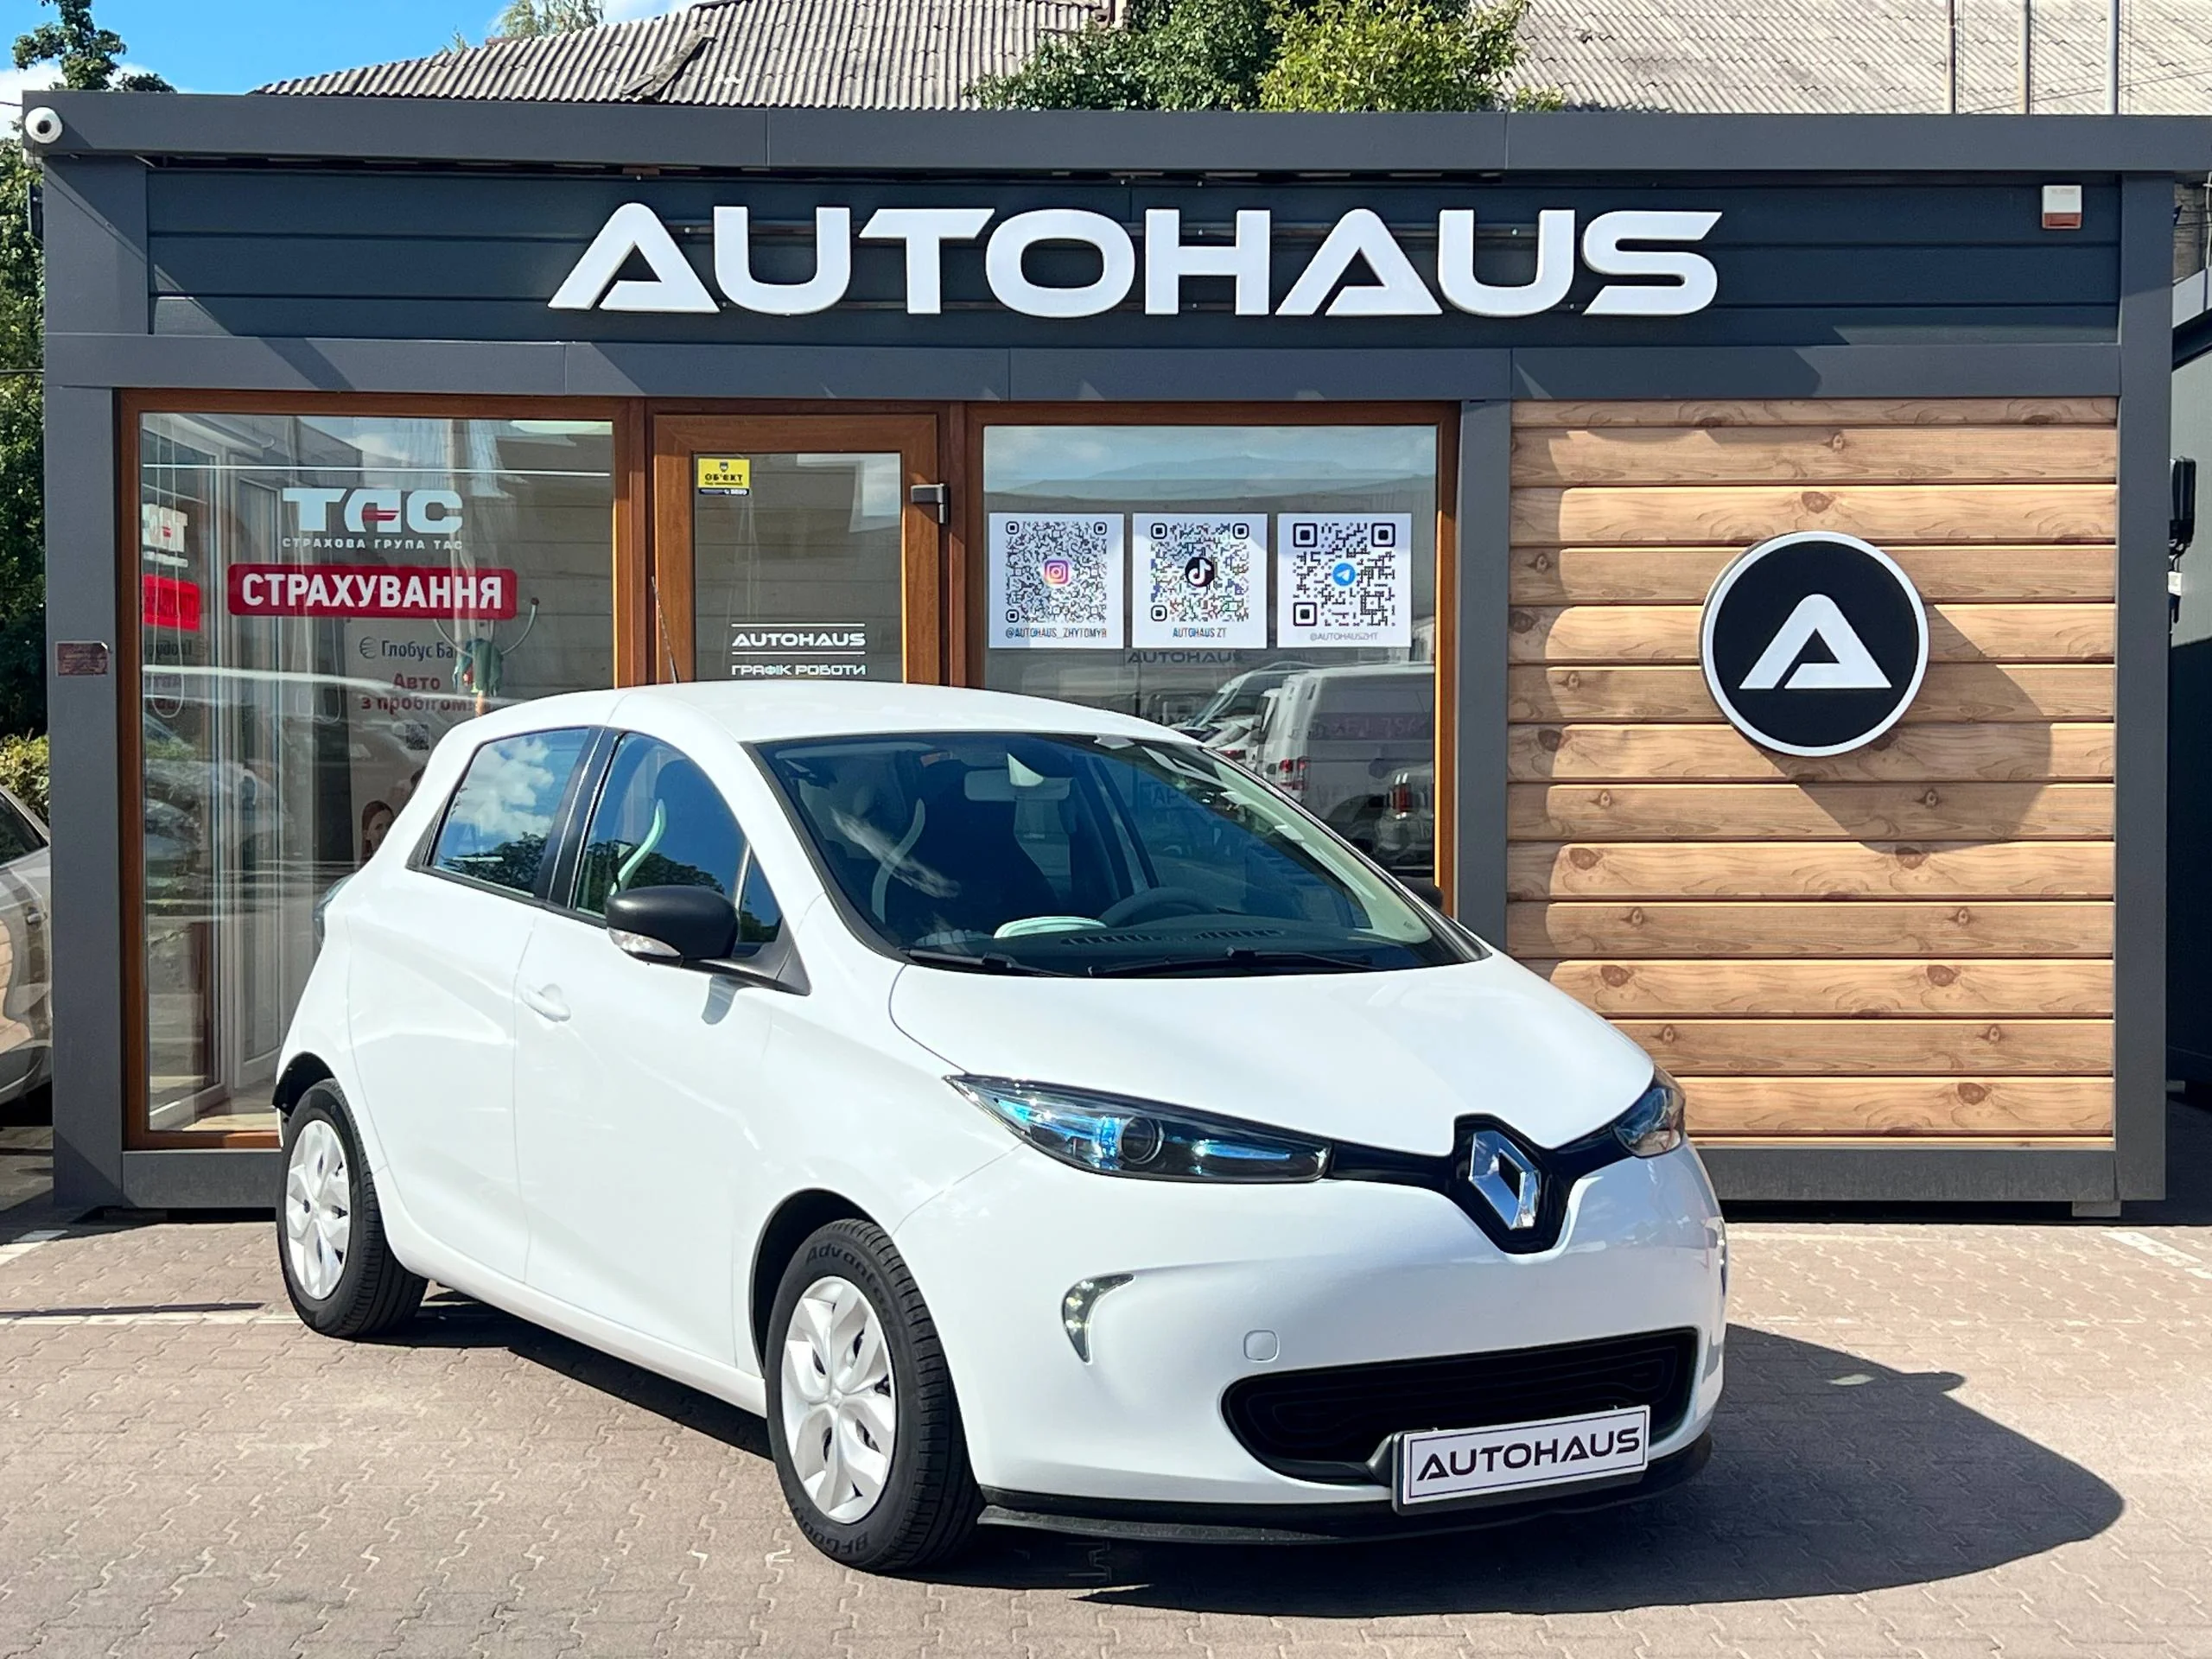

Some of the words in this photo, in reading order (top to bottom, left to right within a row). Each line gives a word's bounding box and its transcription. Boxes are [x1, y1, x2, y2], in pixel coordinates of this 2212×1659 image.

[548, 202, 1723, 317] AUTOHAUS
[282, 537, 366, 550] СТРАХОВА
[374, 538, 426, 550] ГРУПА
[434, 539, 463, 550] ТАС
[242, 573, 502, 609] СТРАХУВАННЯ
[731, 632, 866, 647] AUTOHAUS
[1738, 594, 1892, 690] A
[382, 640, 433, 662] Глобус
[436, 641, 454, 659] Ба
[732, 664, 792, 676] ГРАФІК
[795, 664, 866, 676] РОБОТИ
[393, 673, 441, 690] Авто
[1417, 1427, 1640, 1482] AUTOHAUS
